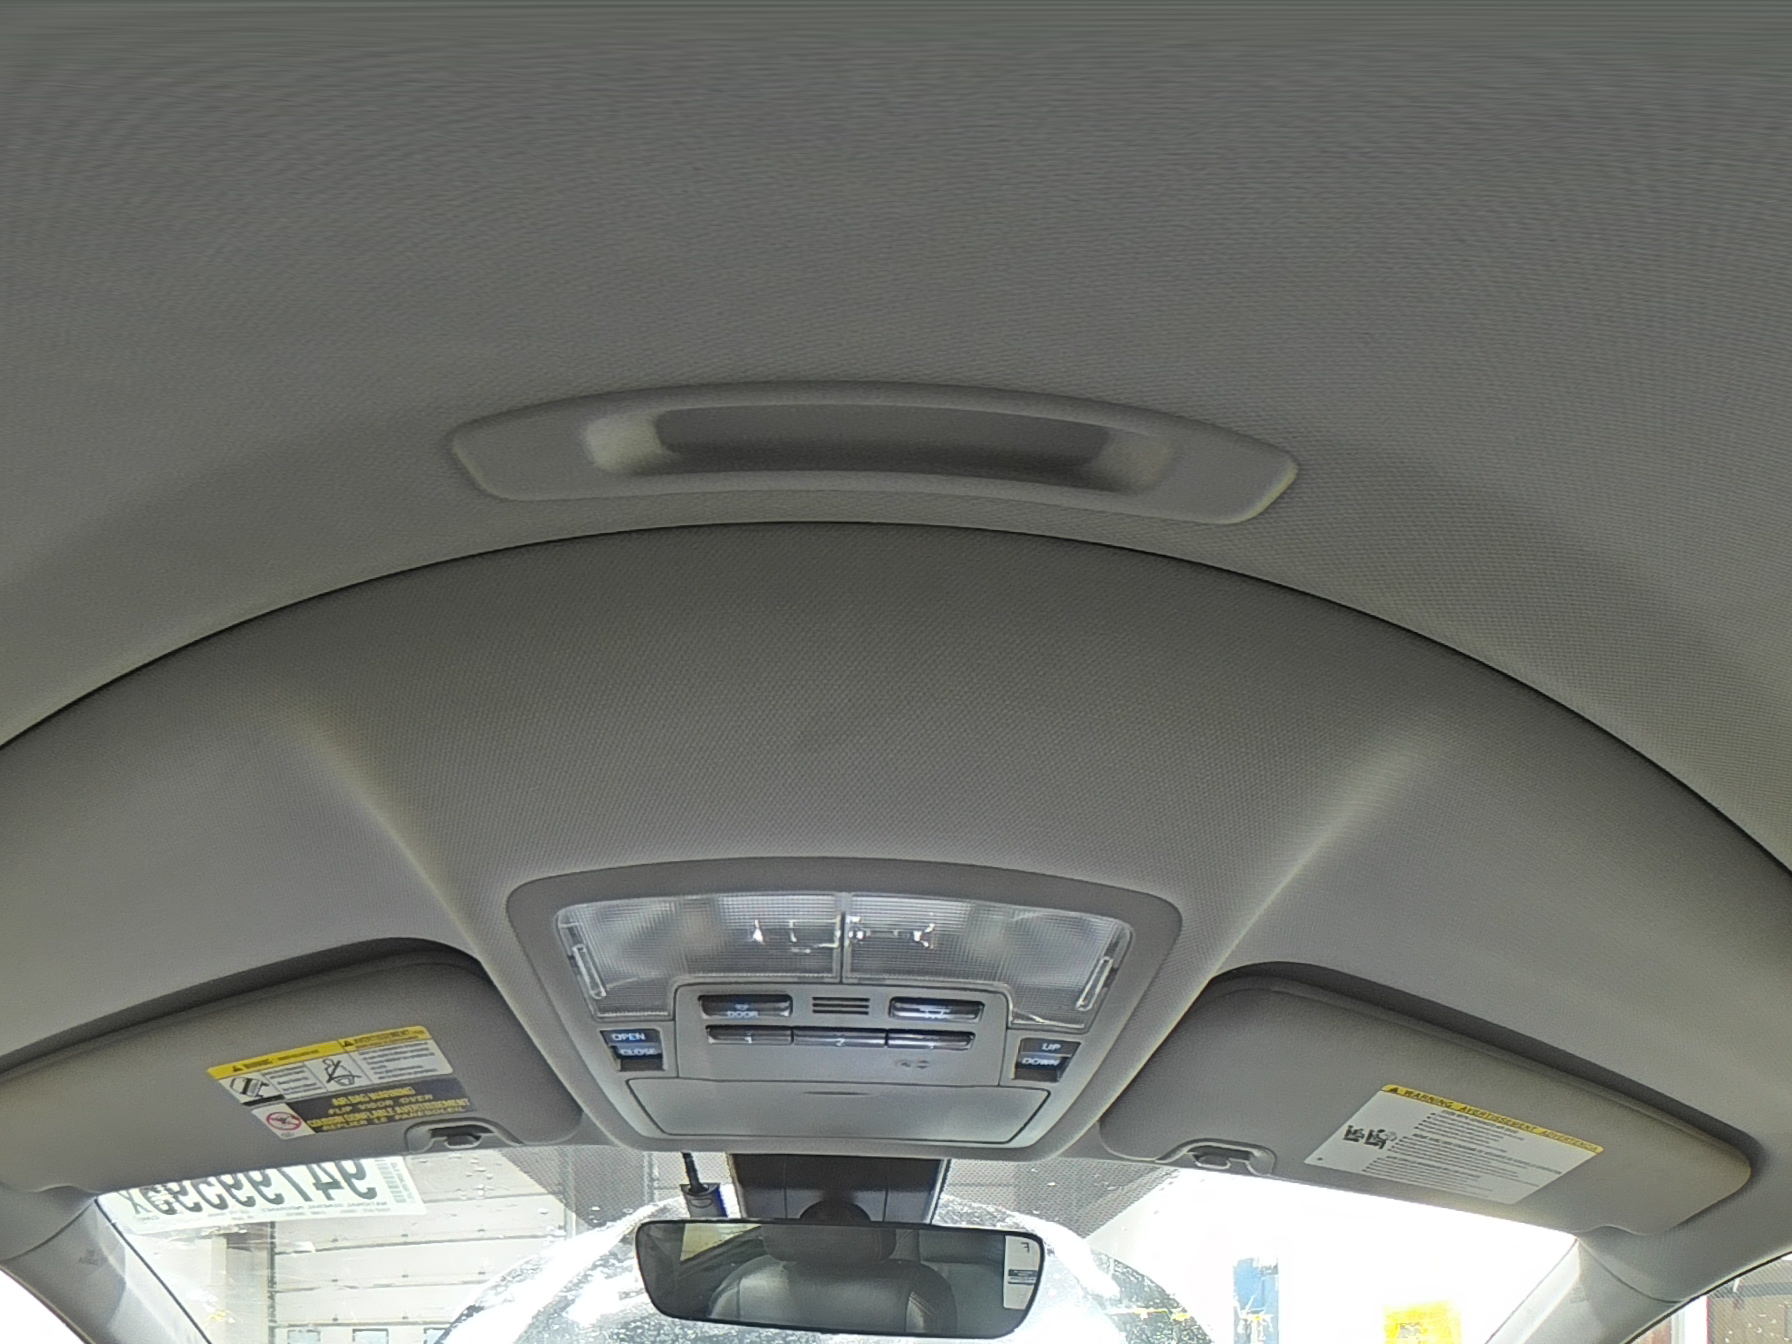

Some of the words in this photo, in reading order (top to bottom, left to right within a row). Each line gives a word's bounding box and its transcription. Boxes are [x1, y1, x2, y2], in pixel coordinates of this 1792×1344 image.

[611, 1032, 645, 1041] OPEN
[620, 1047, 657, 1057] CLOSE
[1042, 1043, 1062, 1052] UP
[1021, 1056, 1060, 1066] DOWN
[1403, 1089, 1454, 1109] WARNING
